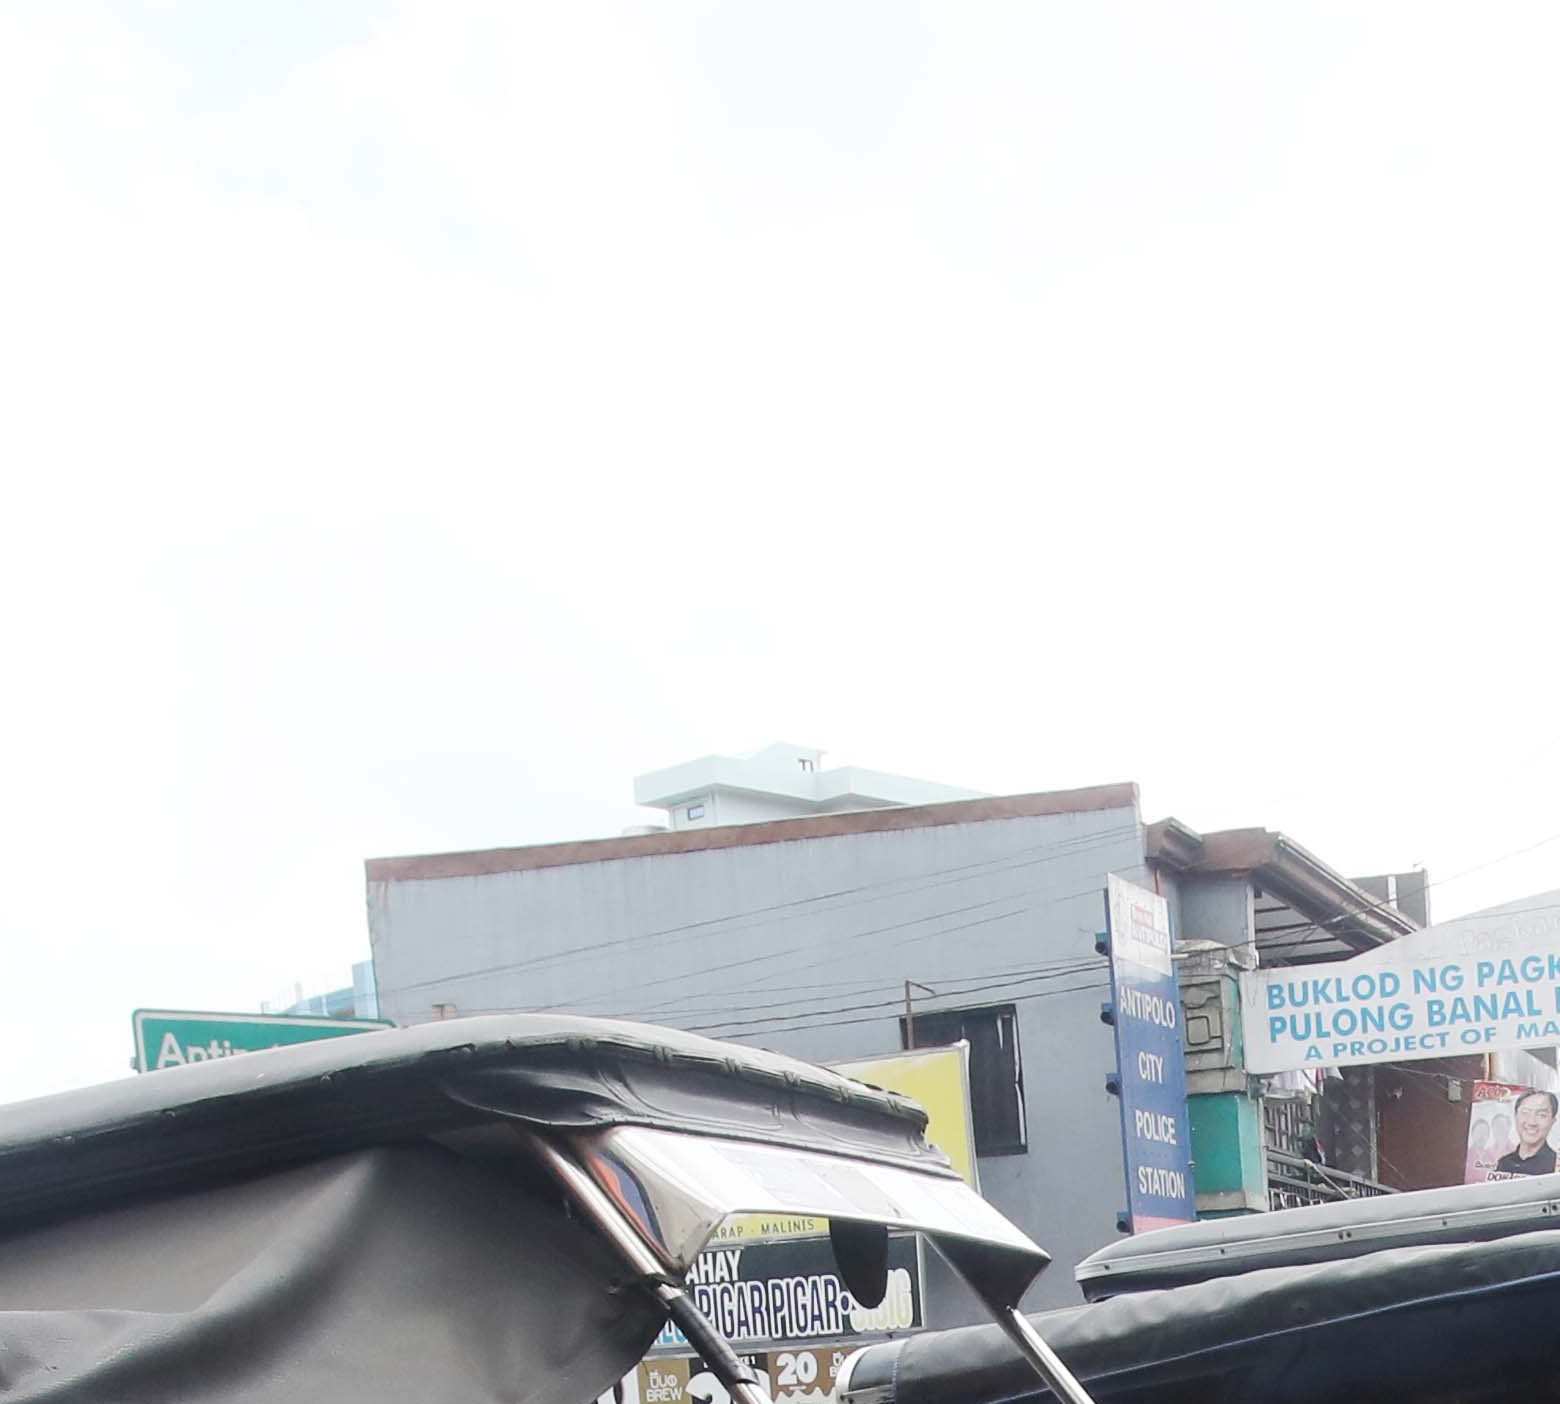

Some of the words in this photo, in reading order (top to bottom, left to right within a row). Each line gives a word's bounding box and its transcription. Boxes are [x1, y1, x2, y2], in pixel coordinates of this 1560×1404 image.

[1266, 970, 1401, 1011] BUKLOD
[1413, 964, 1463, 996] NG
[1119, 984, 1177, 1030] ANTIPOLO
[1269, 1003, 1415, 1044] PULONG
[1427, 988, 1542, 1029] BANAL
[1304, 1045, 1324, 1062] A
[1332, 1031, 1451, 1060] PROJECT
[1460, 1026, 1498, 1046] OF
[1138, 1050, 1164, 1085] CITY
[1135, 1109, 1177, 1146] POLICE
[1138, 1165, 1186, 1201] STATION
[760, 1218, 816, 1234] MALINIS
[767, 1273, 843, 1339] PIGAR
[777, 1351, 818, 1386] 20
[646, 1386, 683, 1403] BREW
